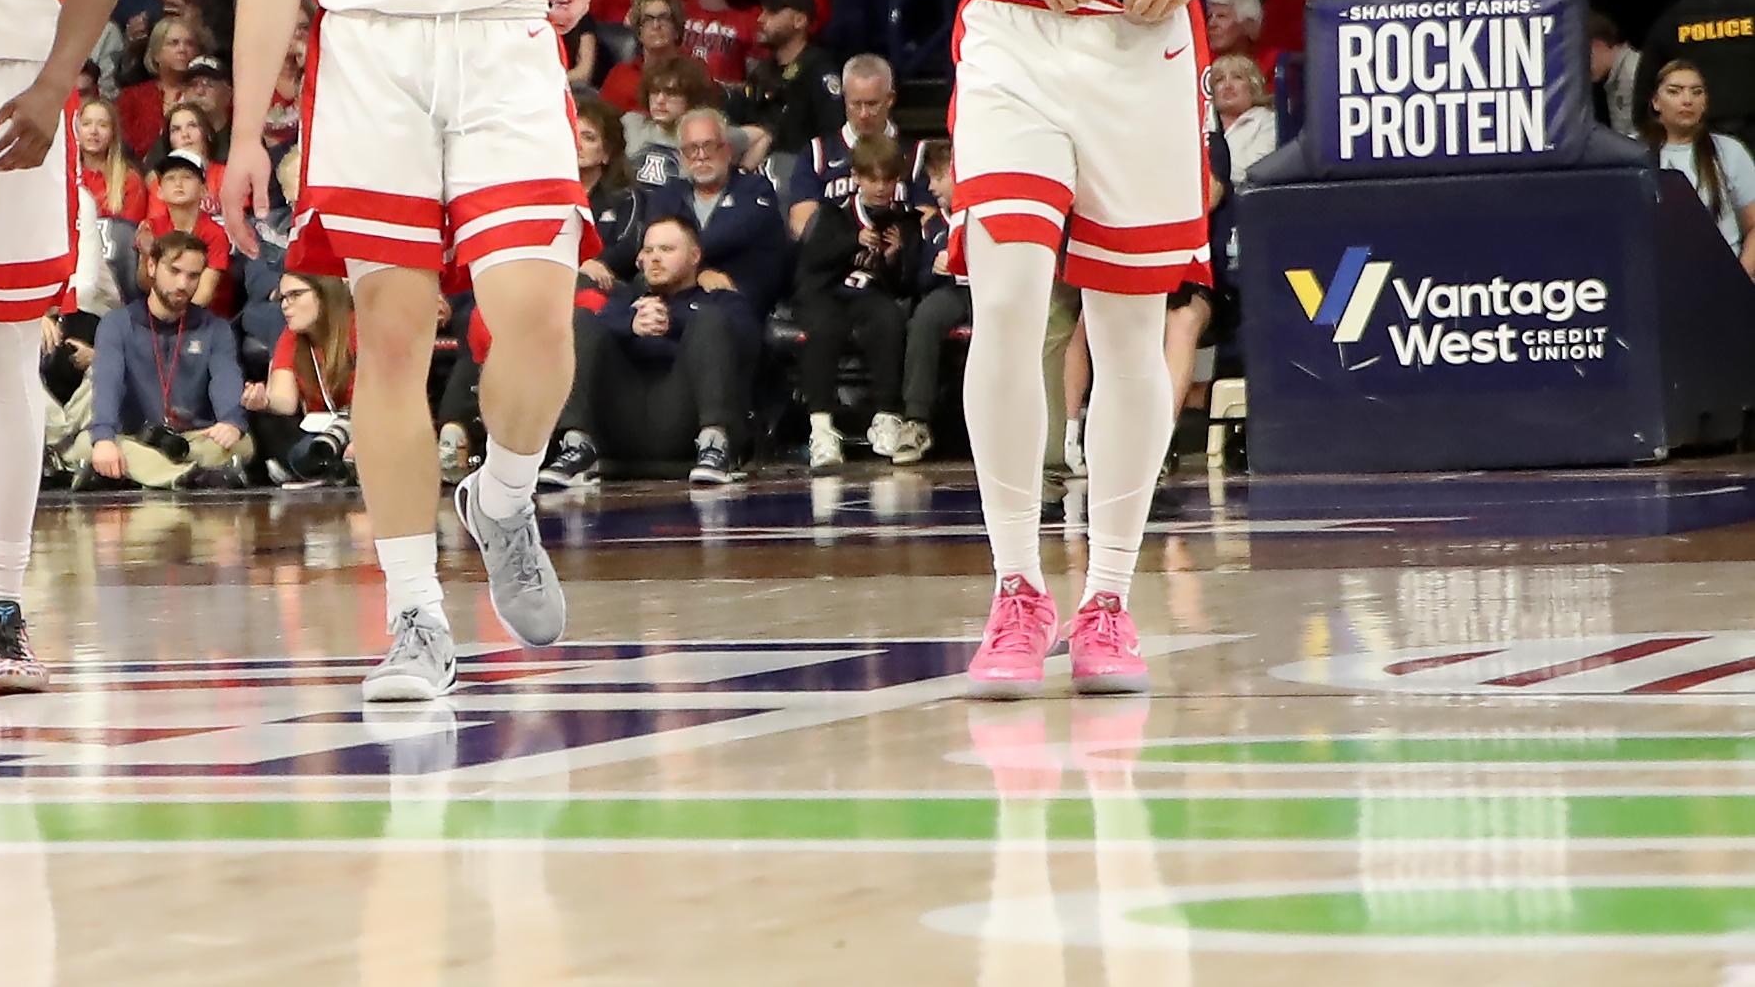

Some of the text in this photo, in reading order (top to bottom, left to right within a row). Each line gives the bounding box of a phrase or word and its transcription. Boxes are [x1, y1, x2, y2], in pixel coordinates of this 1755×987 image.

[1349, 1, 1459, 21] SHAMROCK
[1677, 17, 1754, 44] POLICE
[1339, 89, 1544, 160] PROTEIN
[1392, 276, 1608, 322] Vantage
[1387, 322, 1608, 366] West CREDIT
[1528, 344, 1605, 361] UNION
